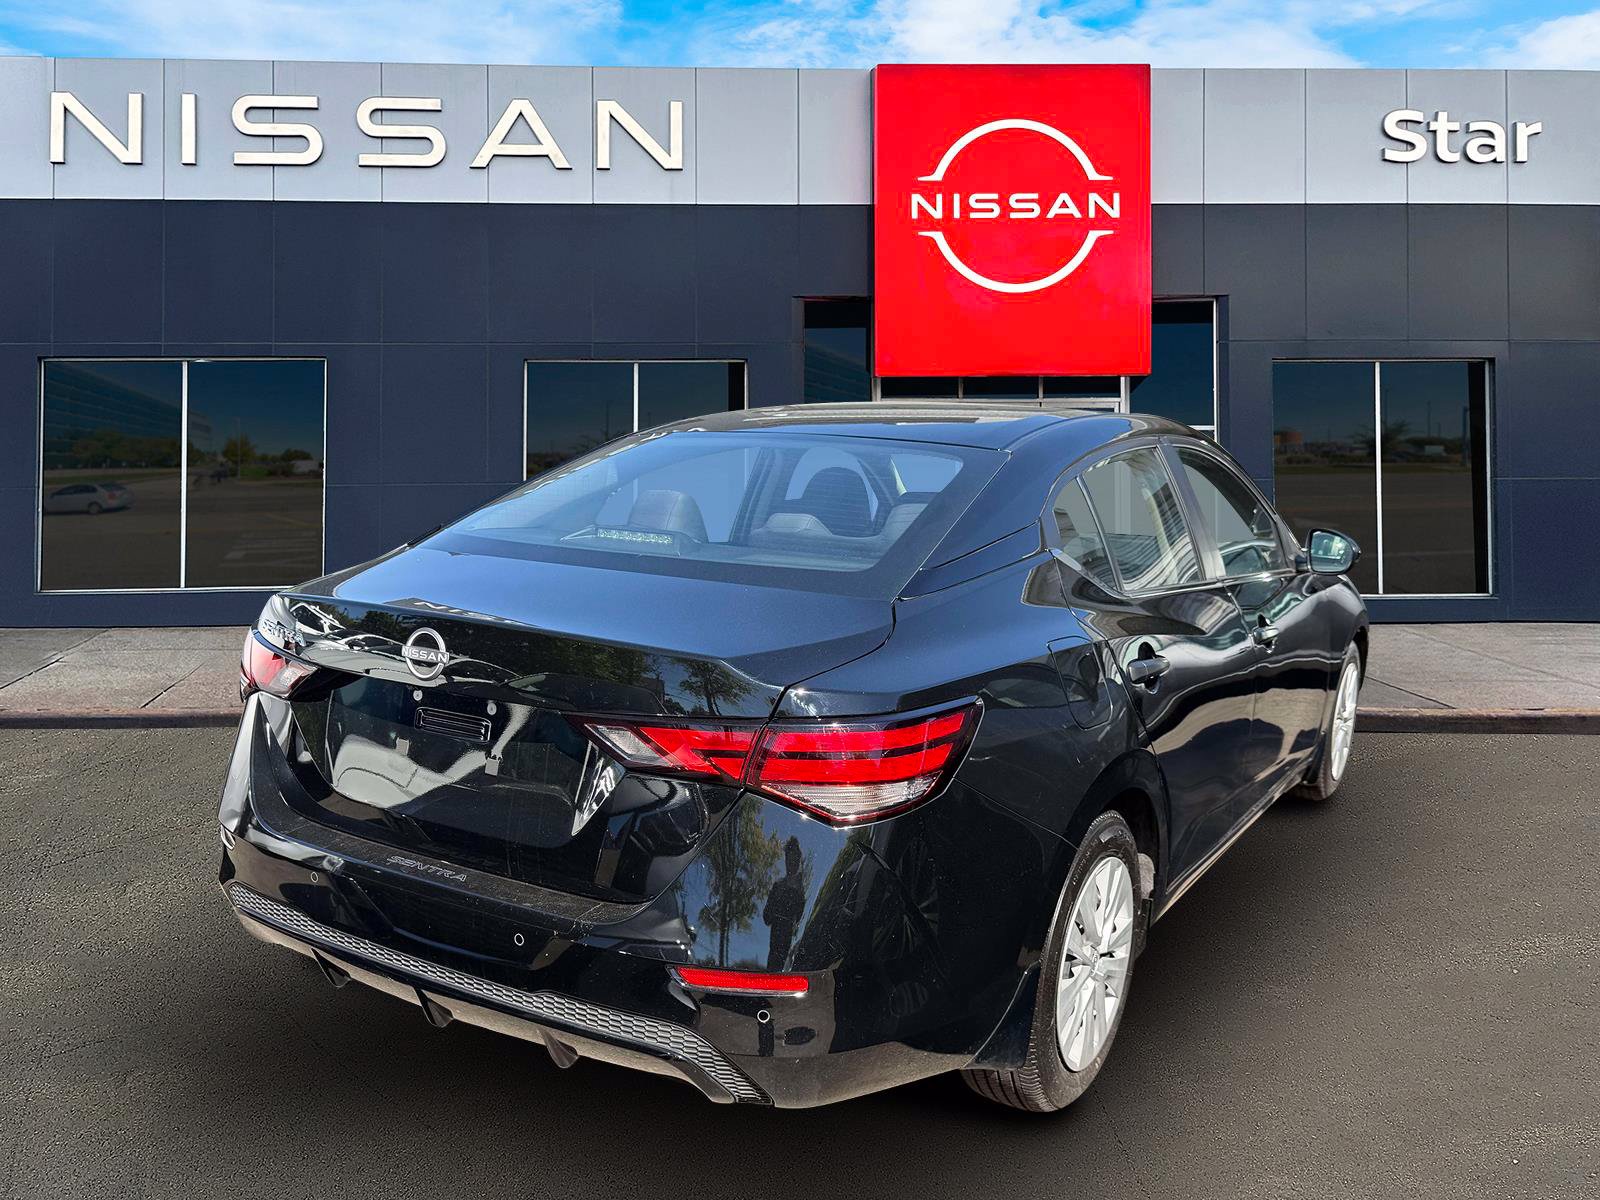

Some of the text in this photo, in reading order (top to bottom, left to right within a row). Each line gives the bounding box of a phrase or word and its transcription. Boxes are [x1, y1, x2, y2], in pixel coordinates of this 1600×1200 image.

[49, 91, 684, 171] NISSAN
[1381, 108, 1543, 164] Star
[911, 192, 1120, 220] NISSAN
[402, 645, 449, 664] NISSAN
[386, 855, 467, 882] SENTRA
